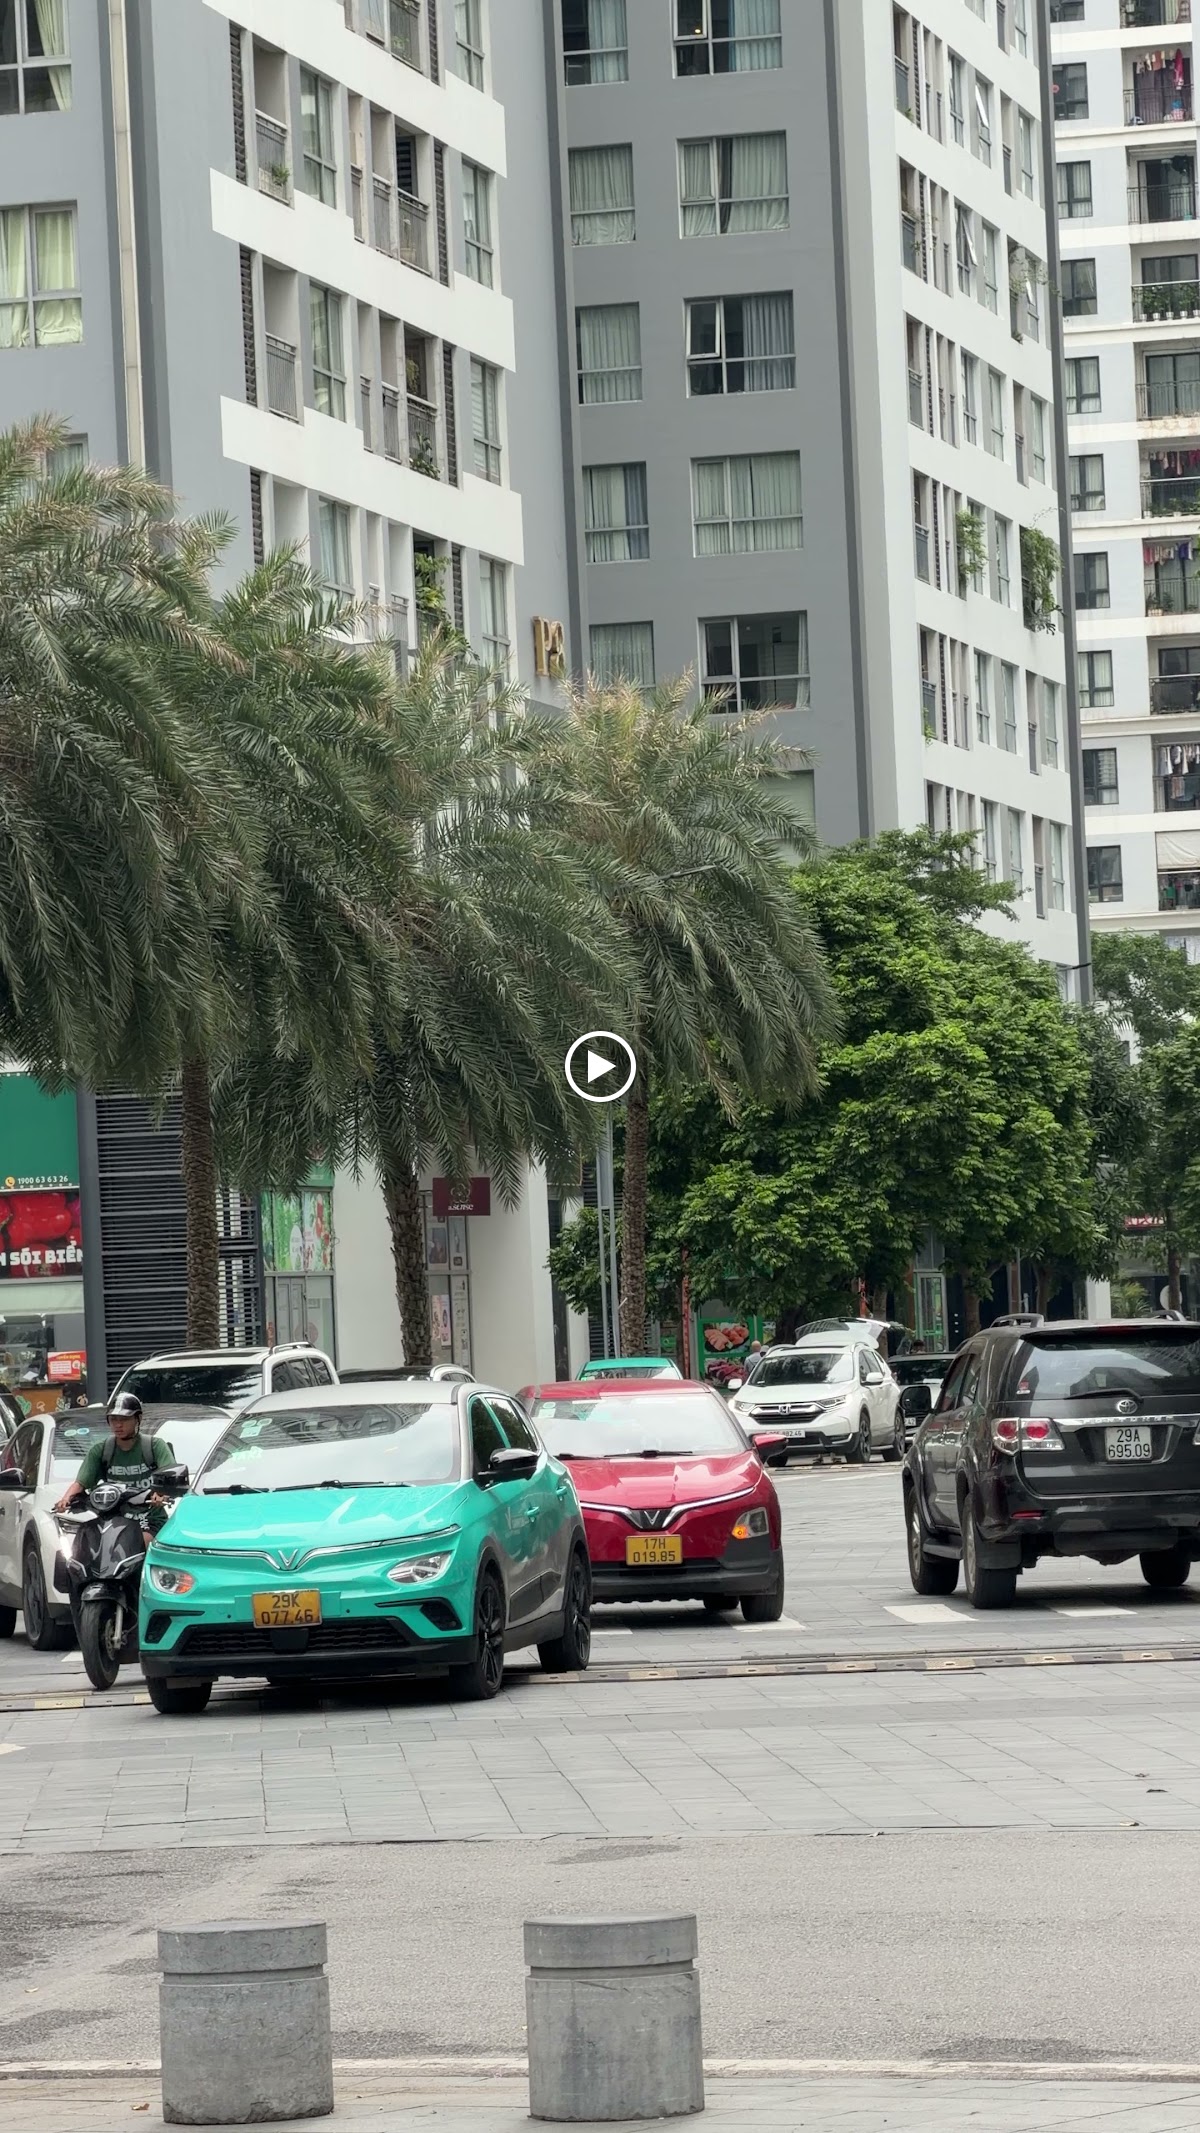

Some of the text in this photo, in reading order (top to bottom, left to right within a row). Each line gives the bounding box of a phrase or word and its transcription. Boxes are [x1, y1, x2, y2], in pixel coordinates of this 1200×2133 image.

[1116, 1428, 1141, 1443] 29A
[1108, 1443, 1151, 1458] 695.09
[644, 1538, 666, 1550] 17H
[633, 1550, 676, 1563] 019.85
[271, 1593, 300, 1609] 29K
[261, 1609, 314, 1625] 077.46
